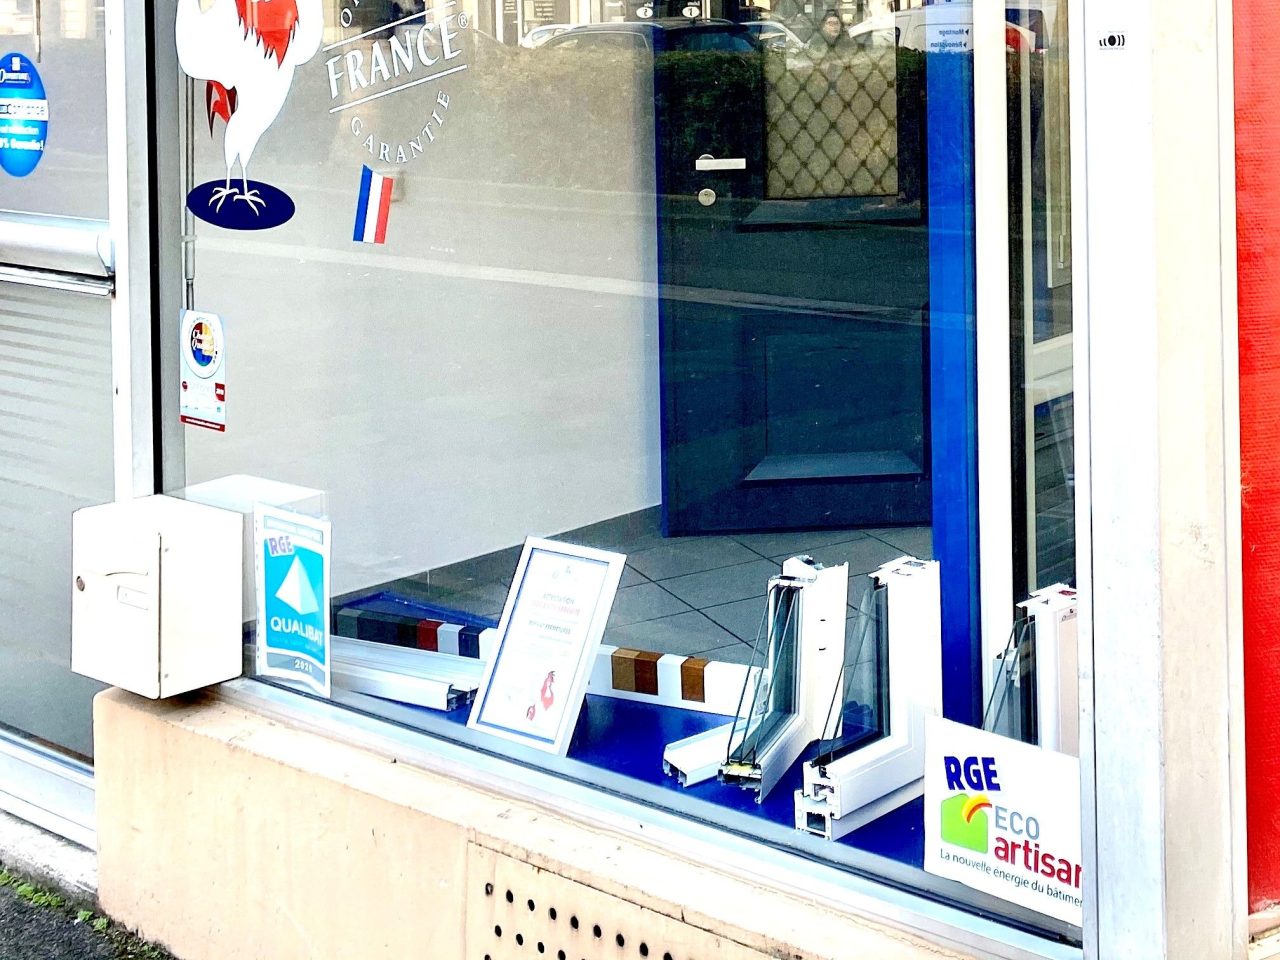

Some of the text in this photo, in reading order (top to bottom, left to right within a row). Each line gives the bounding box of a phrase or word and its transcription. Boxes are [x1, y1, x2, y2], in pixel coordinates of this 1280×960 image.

[351, 90, 450, 164] GARANTIE
[268, 535, 294, 556] RGE
[269, 616, 323, 647] QUALIBAT
[943, 755, 1001, 792] RGE
[994, 804, 1041, 841] ECO
[940, 848, 1083, 908] La nouvelle énergie du bâtime
